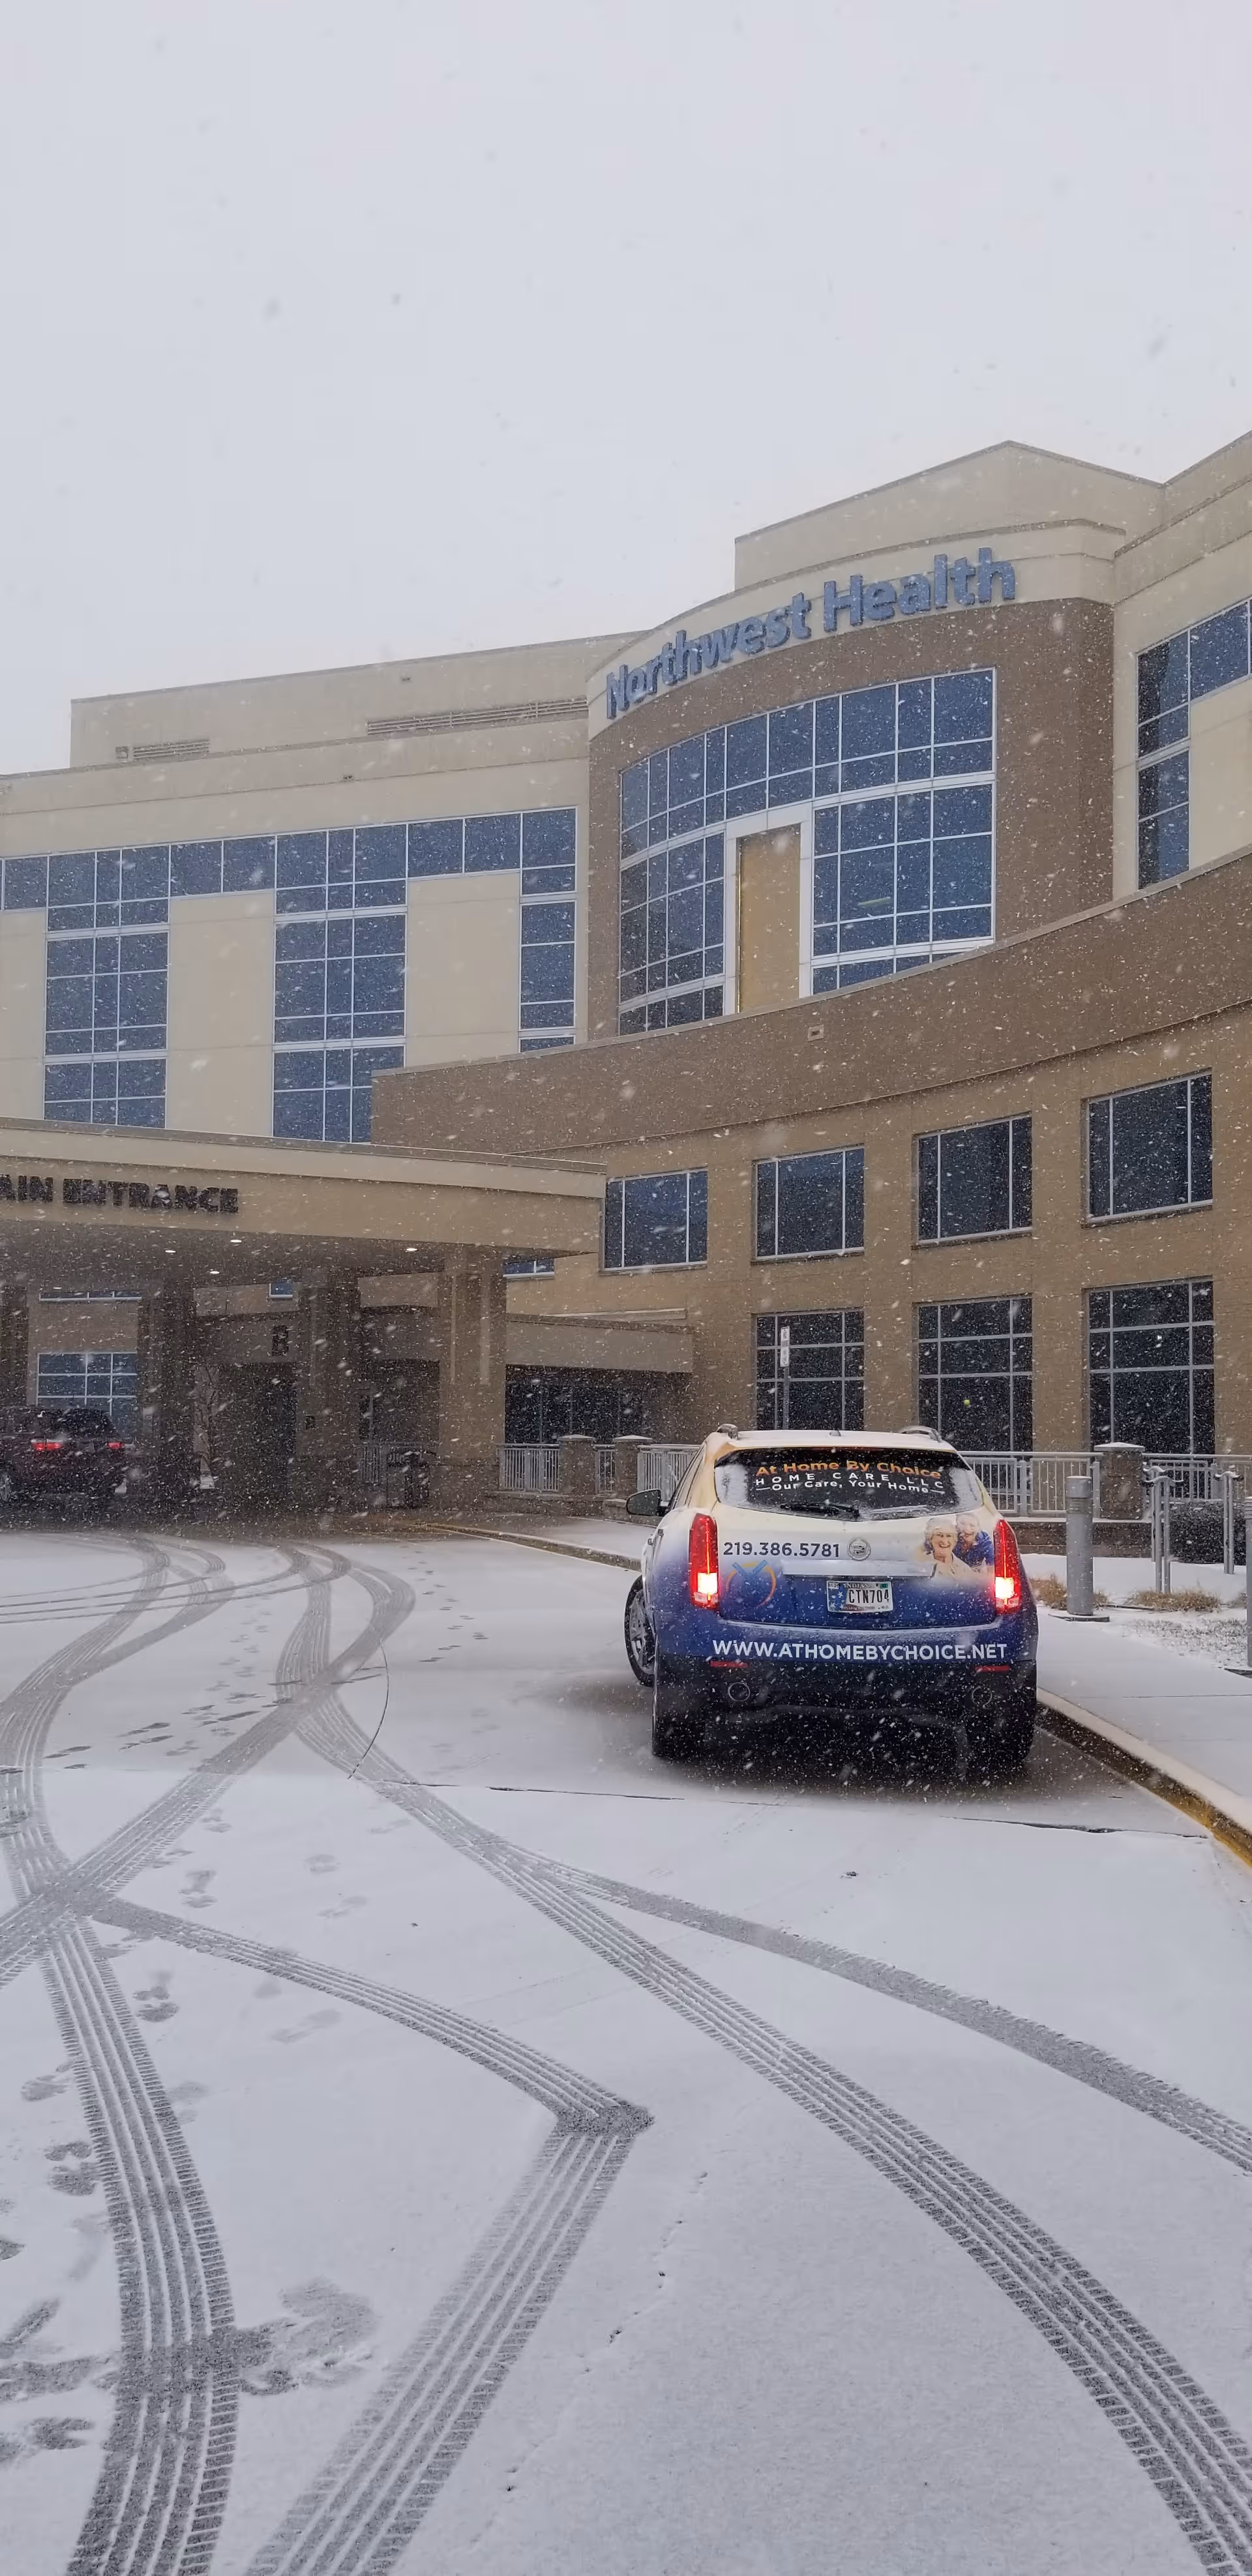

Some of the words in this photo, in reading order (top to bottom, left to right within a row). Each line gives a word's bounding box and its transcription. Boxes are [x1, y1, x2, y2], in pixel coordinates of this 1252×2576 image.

[606, 592, 812, 720] Northwest
[824, 547, 1015, 633] Health
[63, 1178, 239, 1212] ENTRANCE
[756, 1465, 778, 1476] At
[783, 1462, 840, 1473] Home
[846, 1460, 870, 1472] By
[876, 1462, 941, 1479] Choice
[756, 1473, 816, 1486] HOME
[832, 1472, 890, 1482] CARE
[906, 1476, 944, 1488] LLC
[848, 1480, 882, 1488] Your
[723, 1542, 840, 1557] 219.386.5781
[848, 1589, 889, 1604] CTN704
[712, 1639, 1008, 1661] WWW.ATHOMEBYCHOICE.NET
